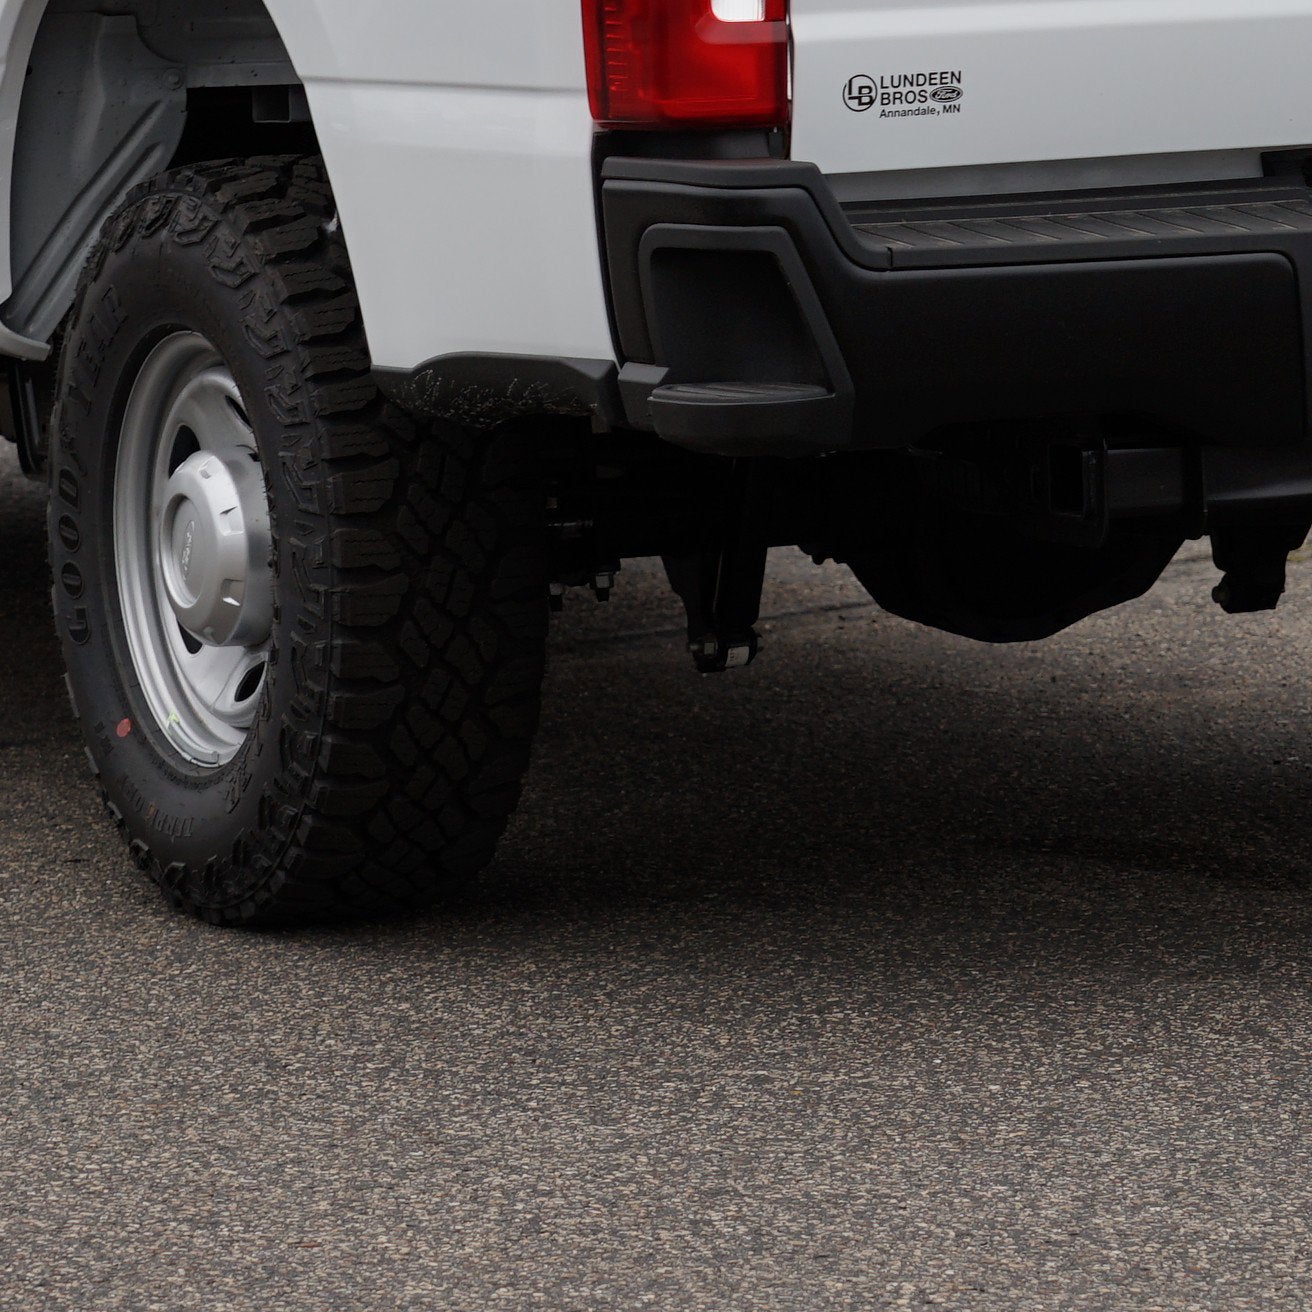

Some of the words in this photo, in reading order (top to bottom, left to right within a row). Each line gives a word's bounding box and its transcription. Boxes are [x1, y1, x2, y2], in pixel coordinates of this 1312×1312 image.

[880, 71, 961, 89] LUNDEEN
[880, 90, 928, 106] BROS
[879, 106, 940, 118] Annandale,
[942, 104, 961, 114] MN
